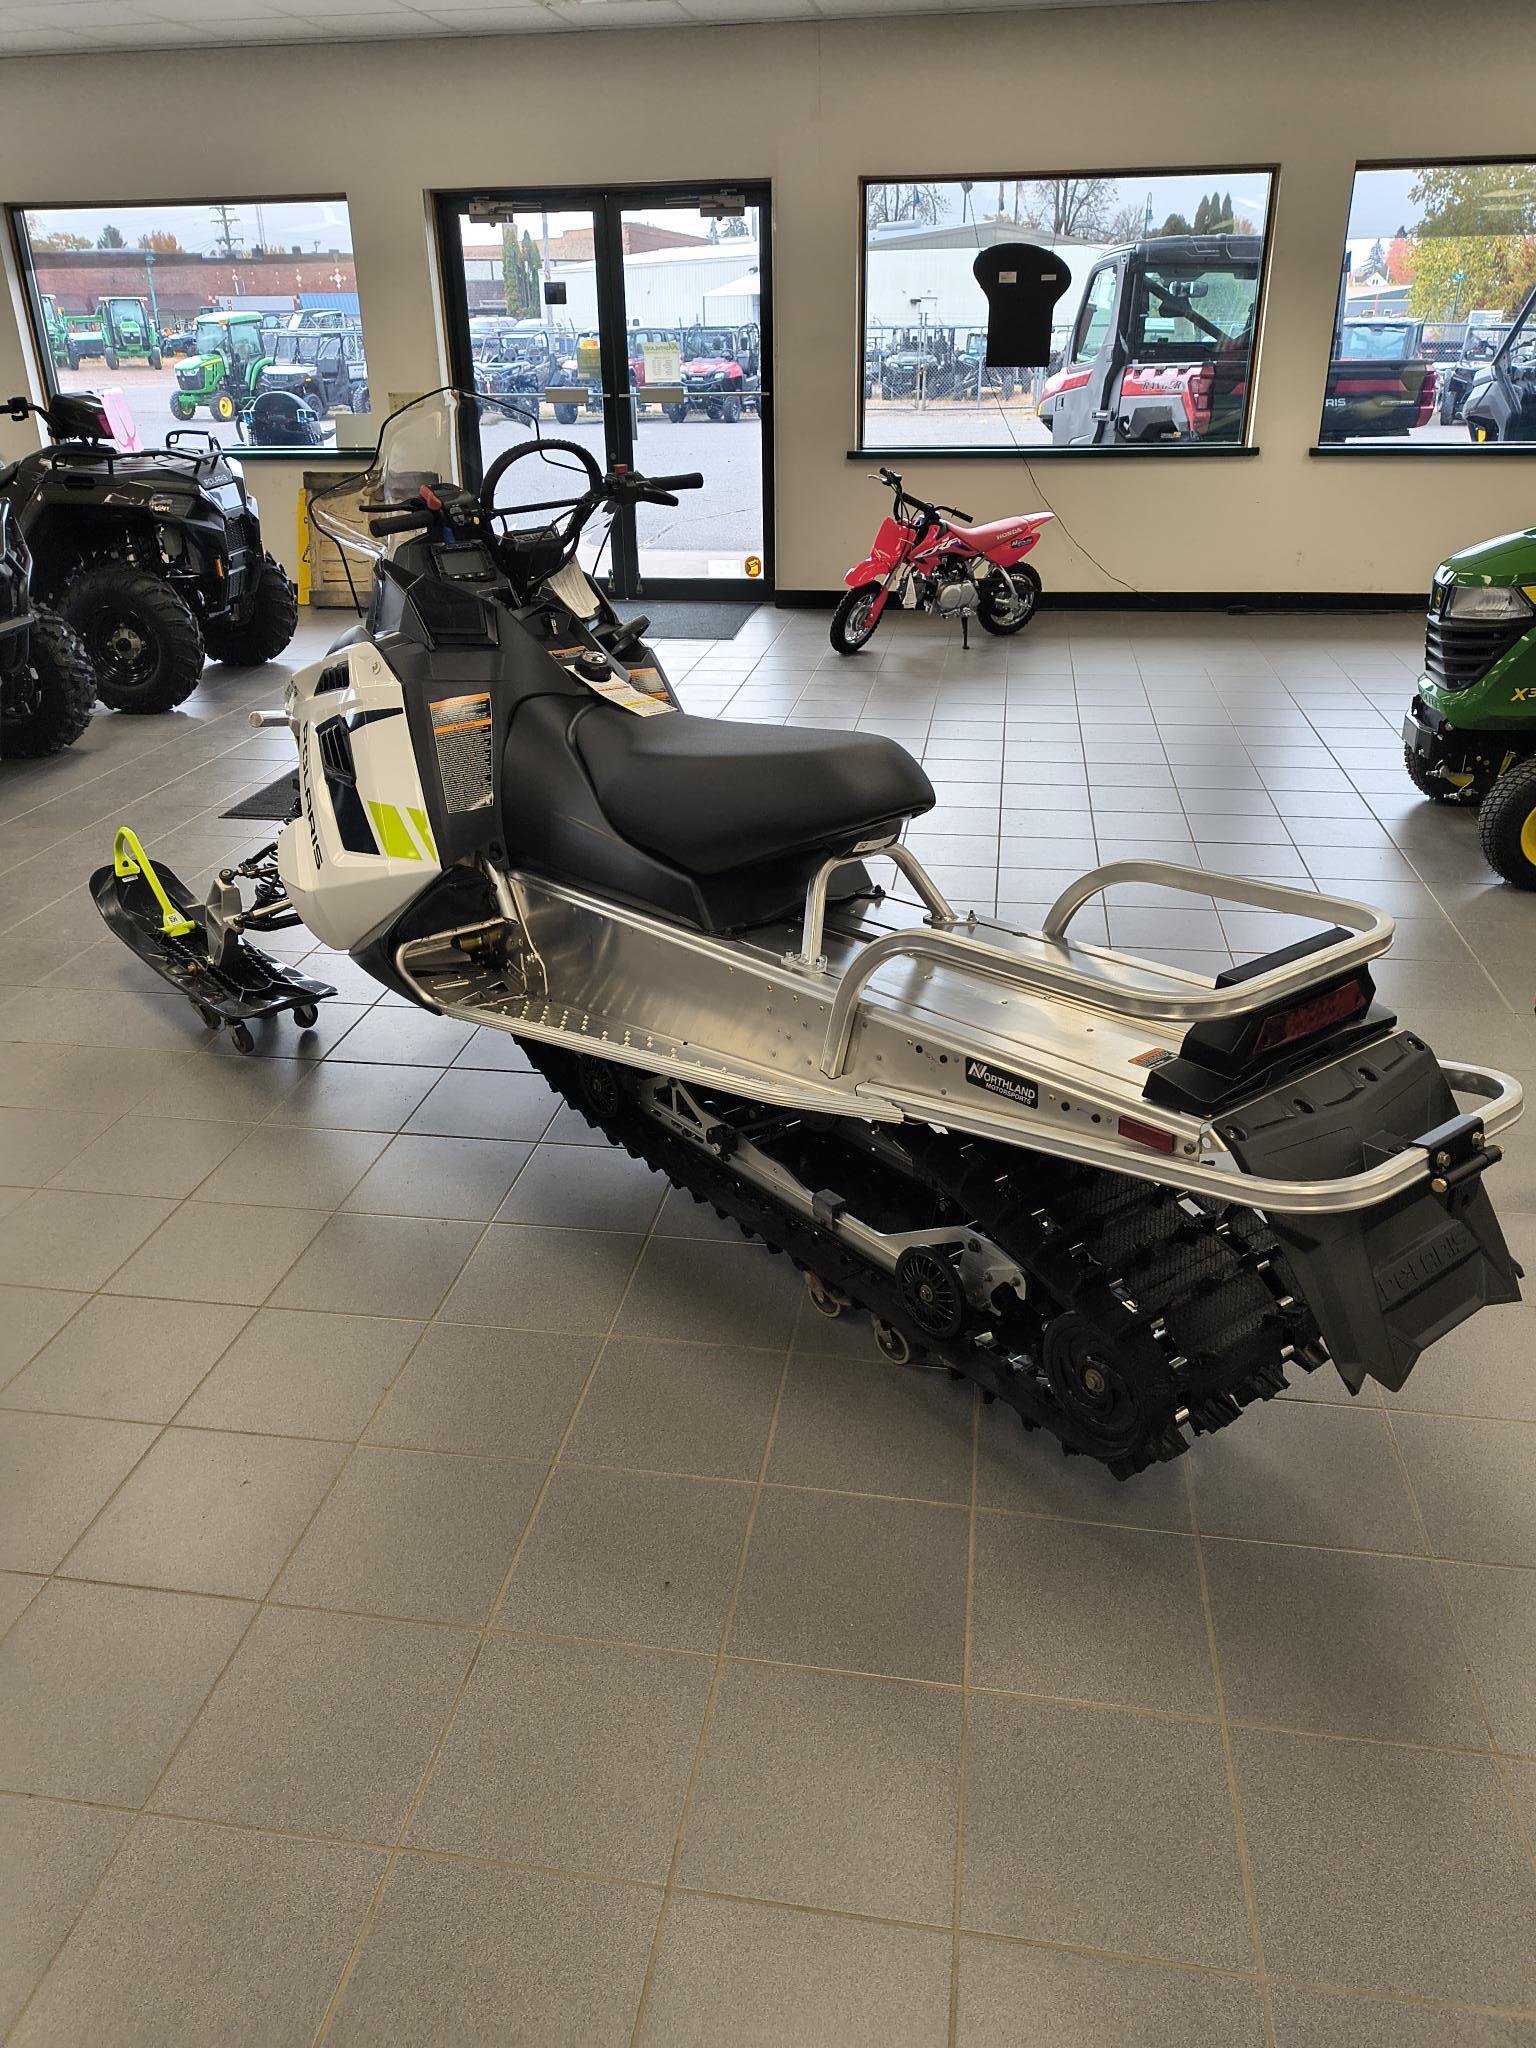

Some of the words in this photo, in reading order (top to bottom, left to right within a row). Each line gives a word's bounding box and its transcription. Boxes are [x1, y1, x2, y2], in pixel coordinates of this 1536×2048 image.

[996, 528, 1023, 540] HONDA
[302, 720, 323, 870] POLARIS
[968, 1062, 1036, 1099] NORTHLAND
[985, 1082, 1032, 1105] MOTORSPORTS
